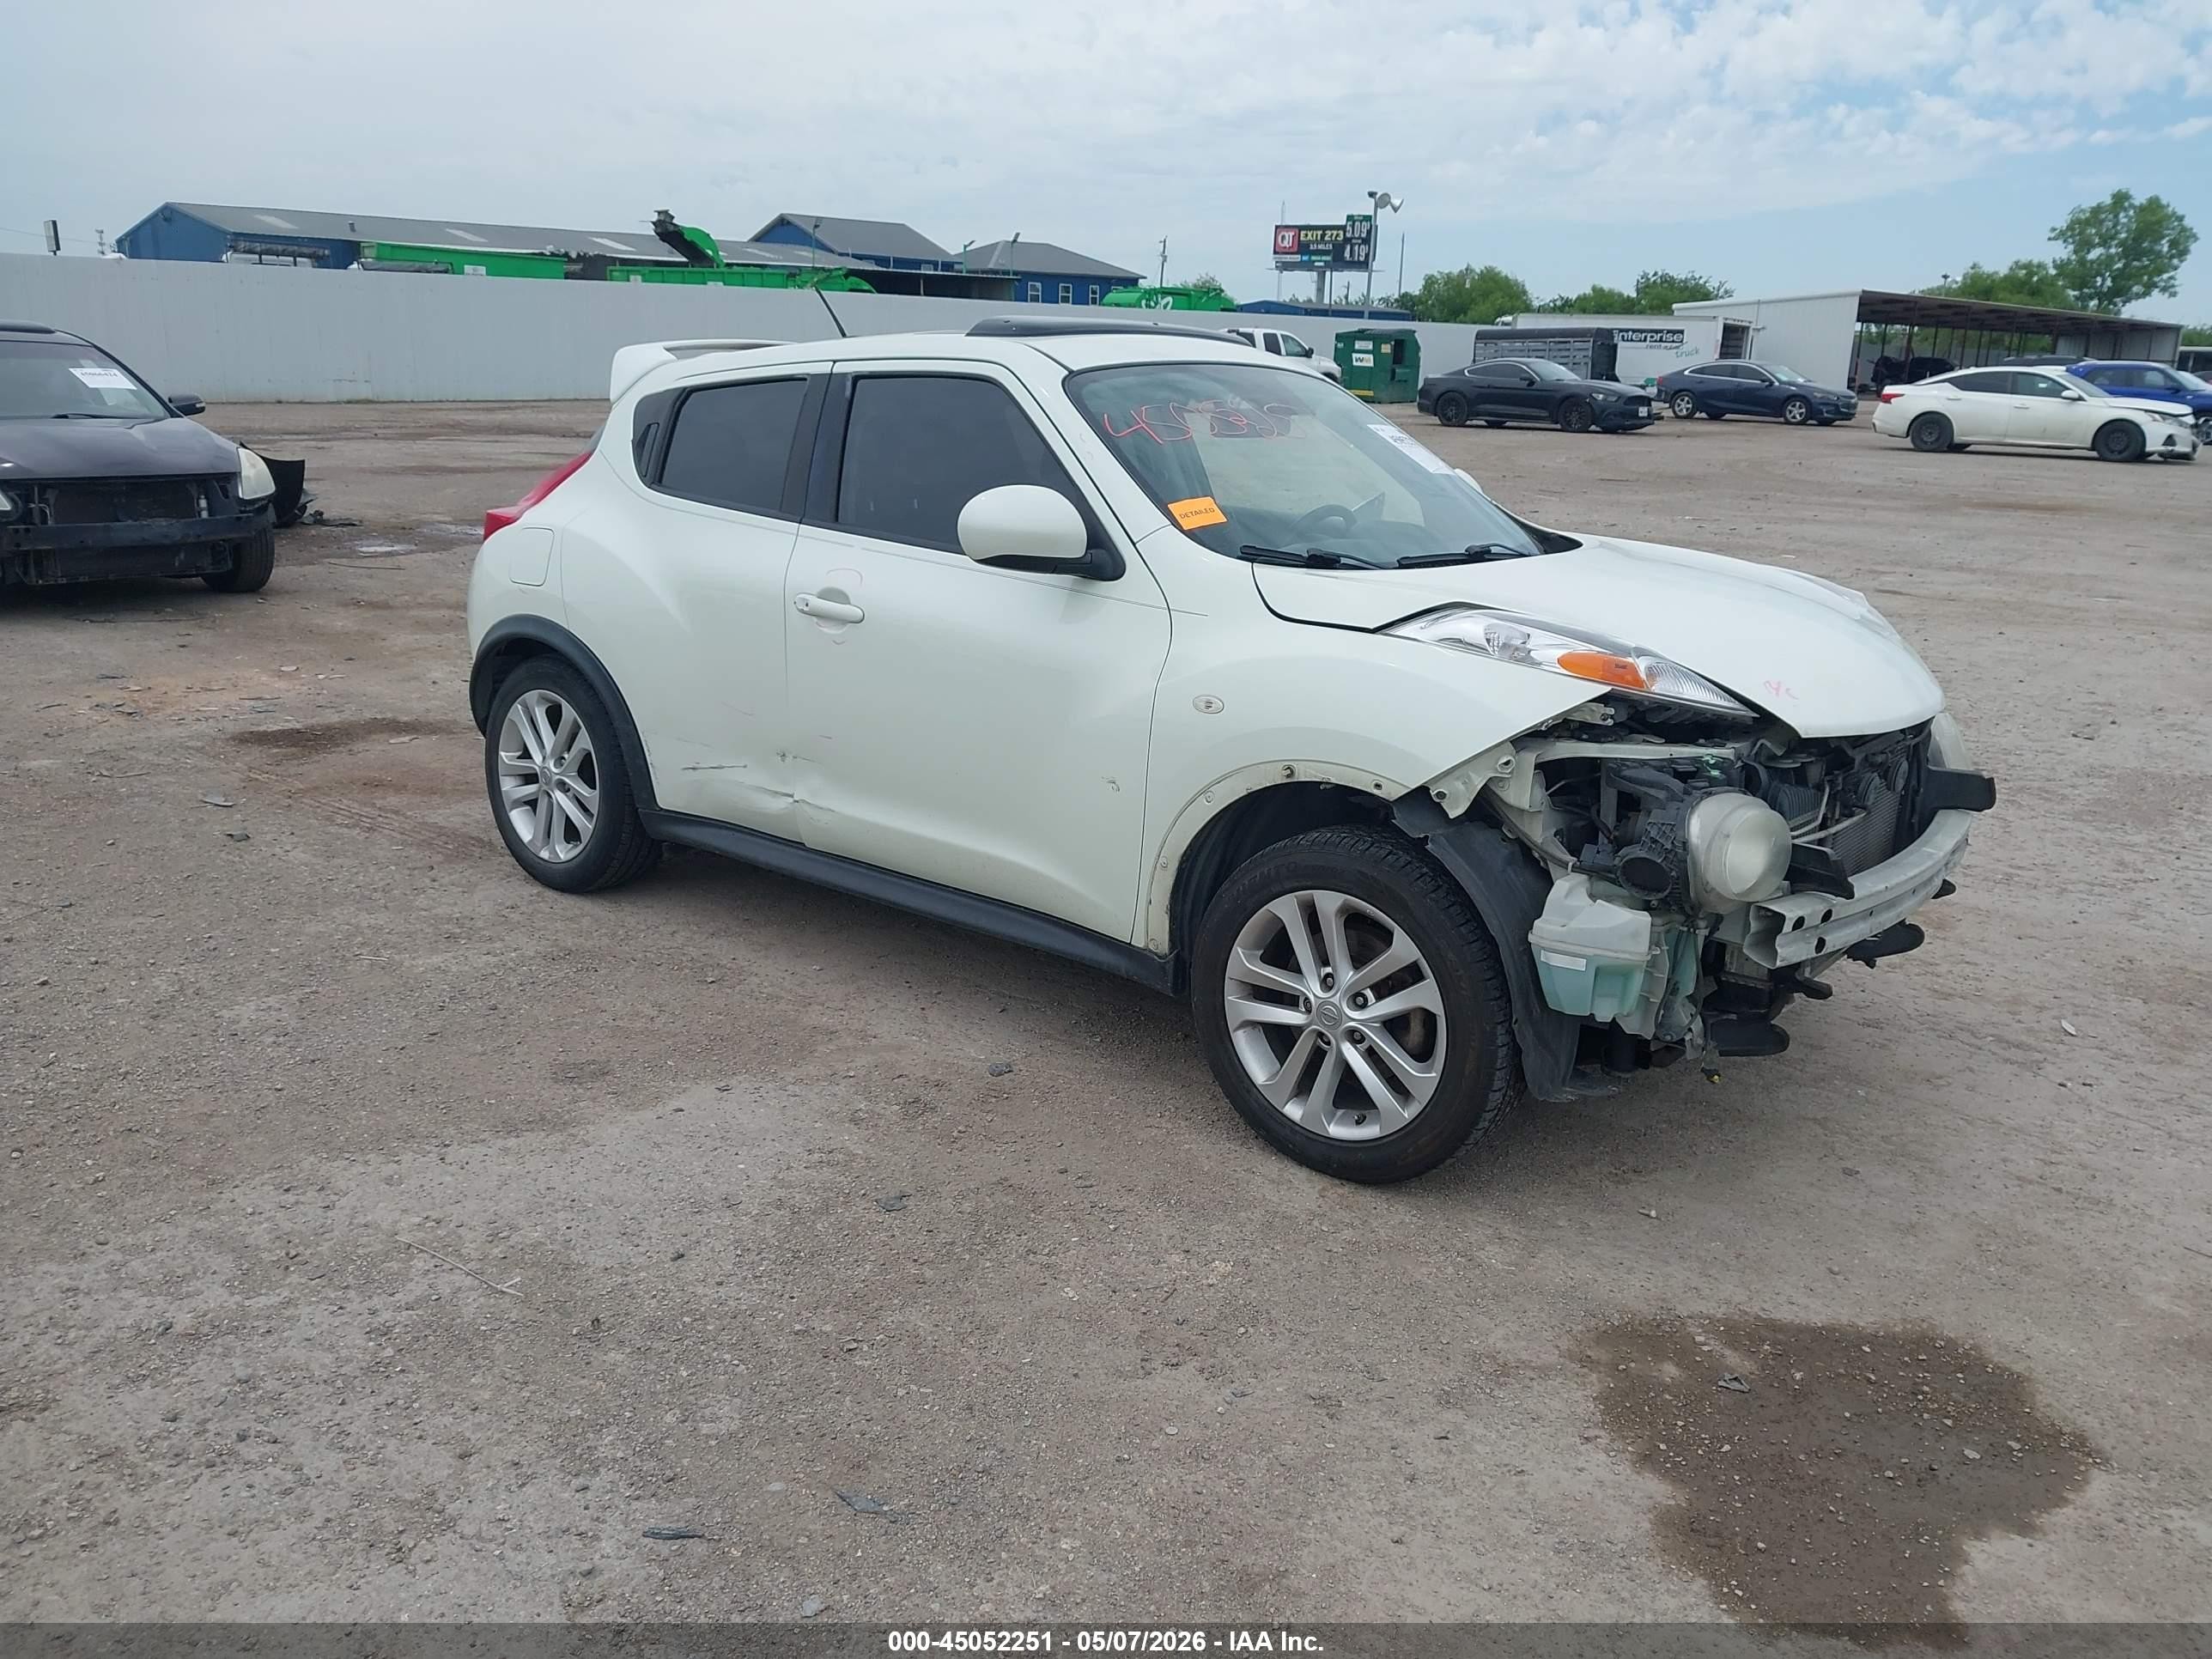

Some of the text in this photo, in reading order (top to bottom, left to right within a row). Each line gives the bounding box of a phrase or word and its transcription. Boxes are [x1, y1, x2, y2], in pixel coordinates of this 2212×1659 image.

[1278, 232, 1295, 247] QT
[1300, 230, 1344, 240] EXIT 273
[1675, 347, 1699, 358] truck
[1179, 507, 1215, 520] DETAILED
